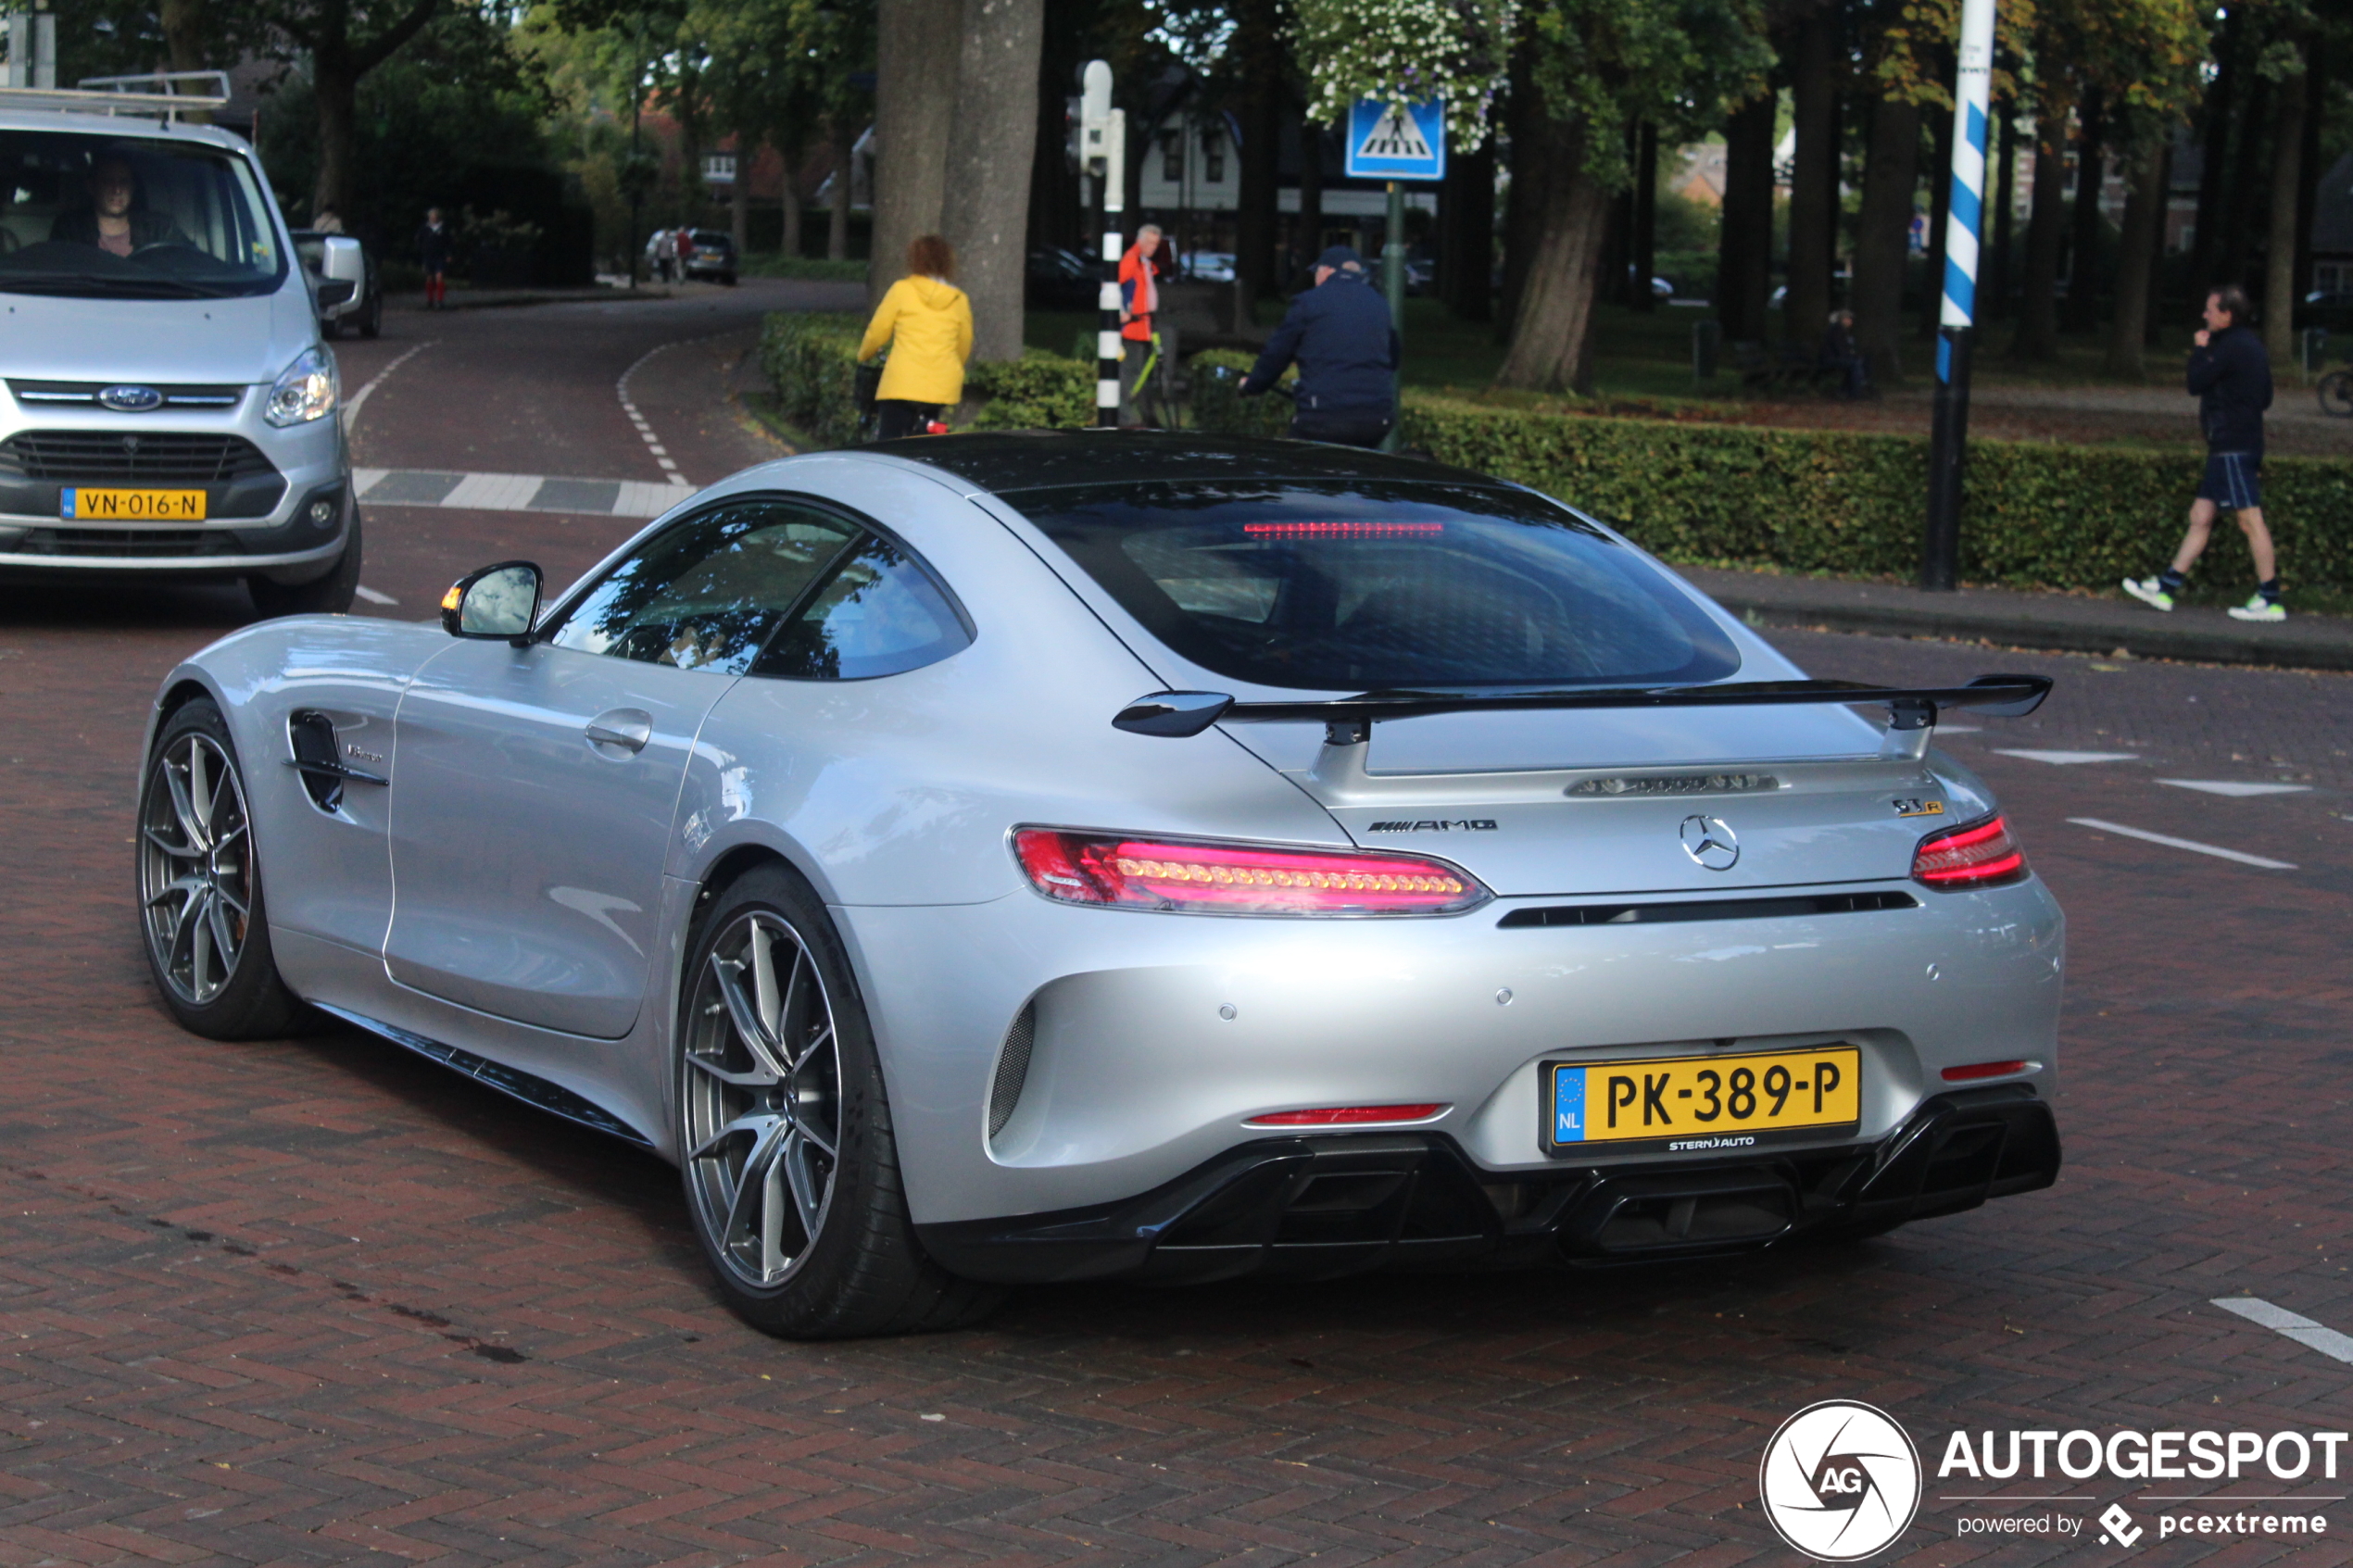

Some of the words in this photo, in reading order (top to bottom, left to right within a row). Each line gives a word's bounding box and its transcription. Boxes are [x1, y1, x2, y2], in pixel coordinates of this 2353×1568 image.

[86, 494, 196, 515] VN-016-N
[1409, 820, 1498, 833] AMG
[1607, 1061, 1842, 1129] PK-389-P
[1559, 1112, 1580, 1130] NL
